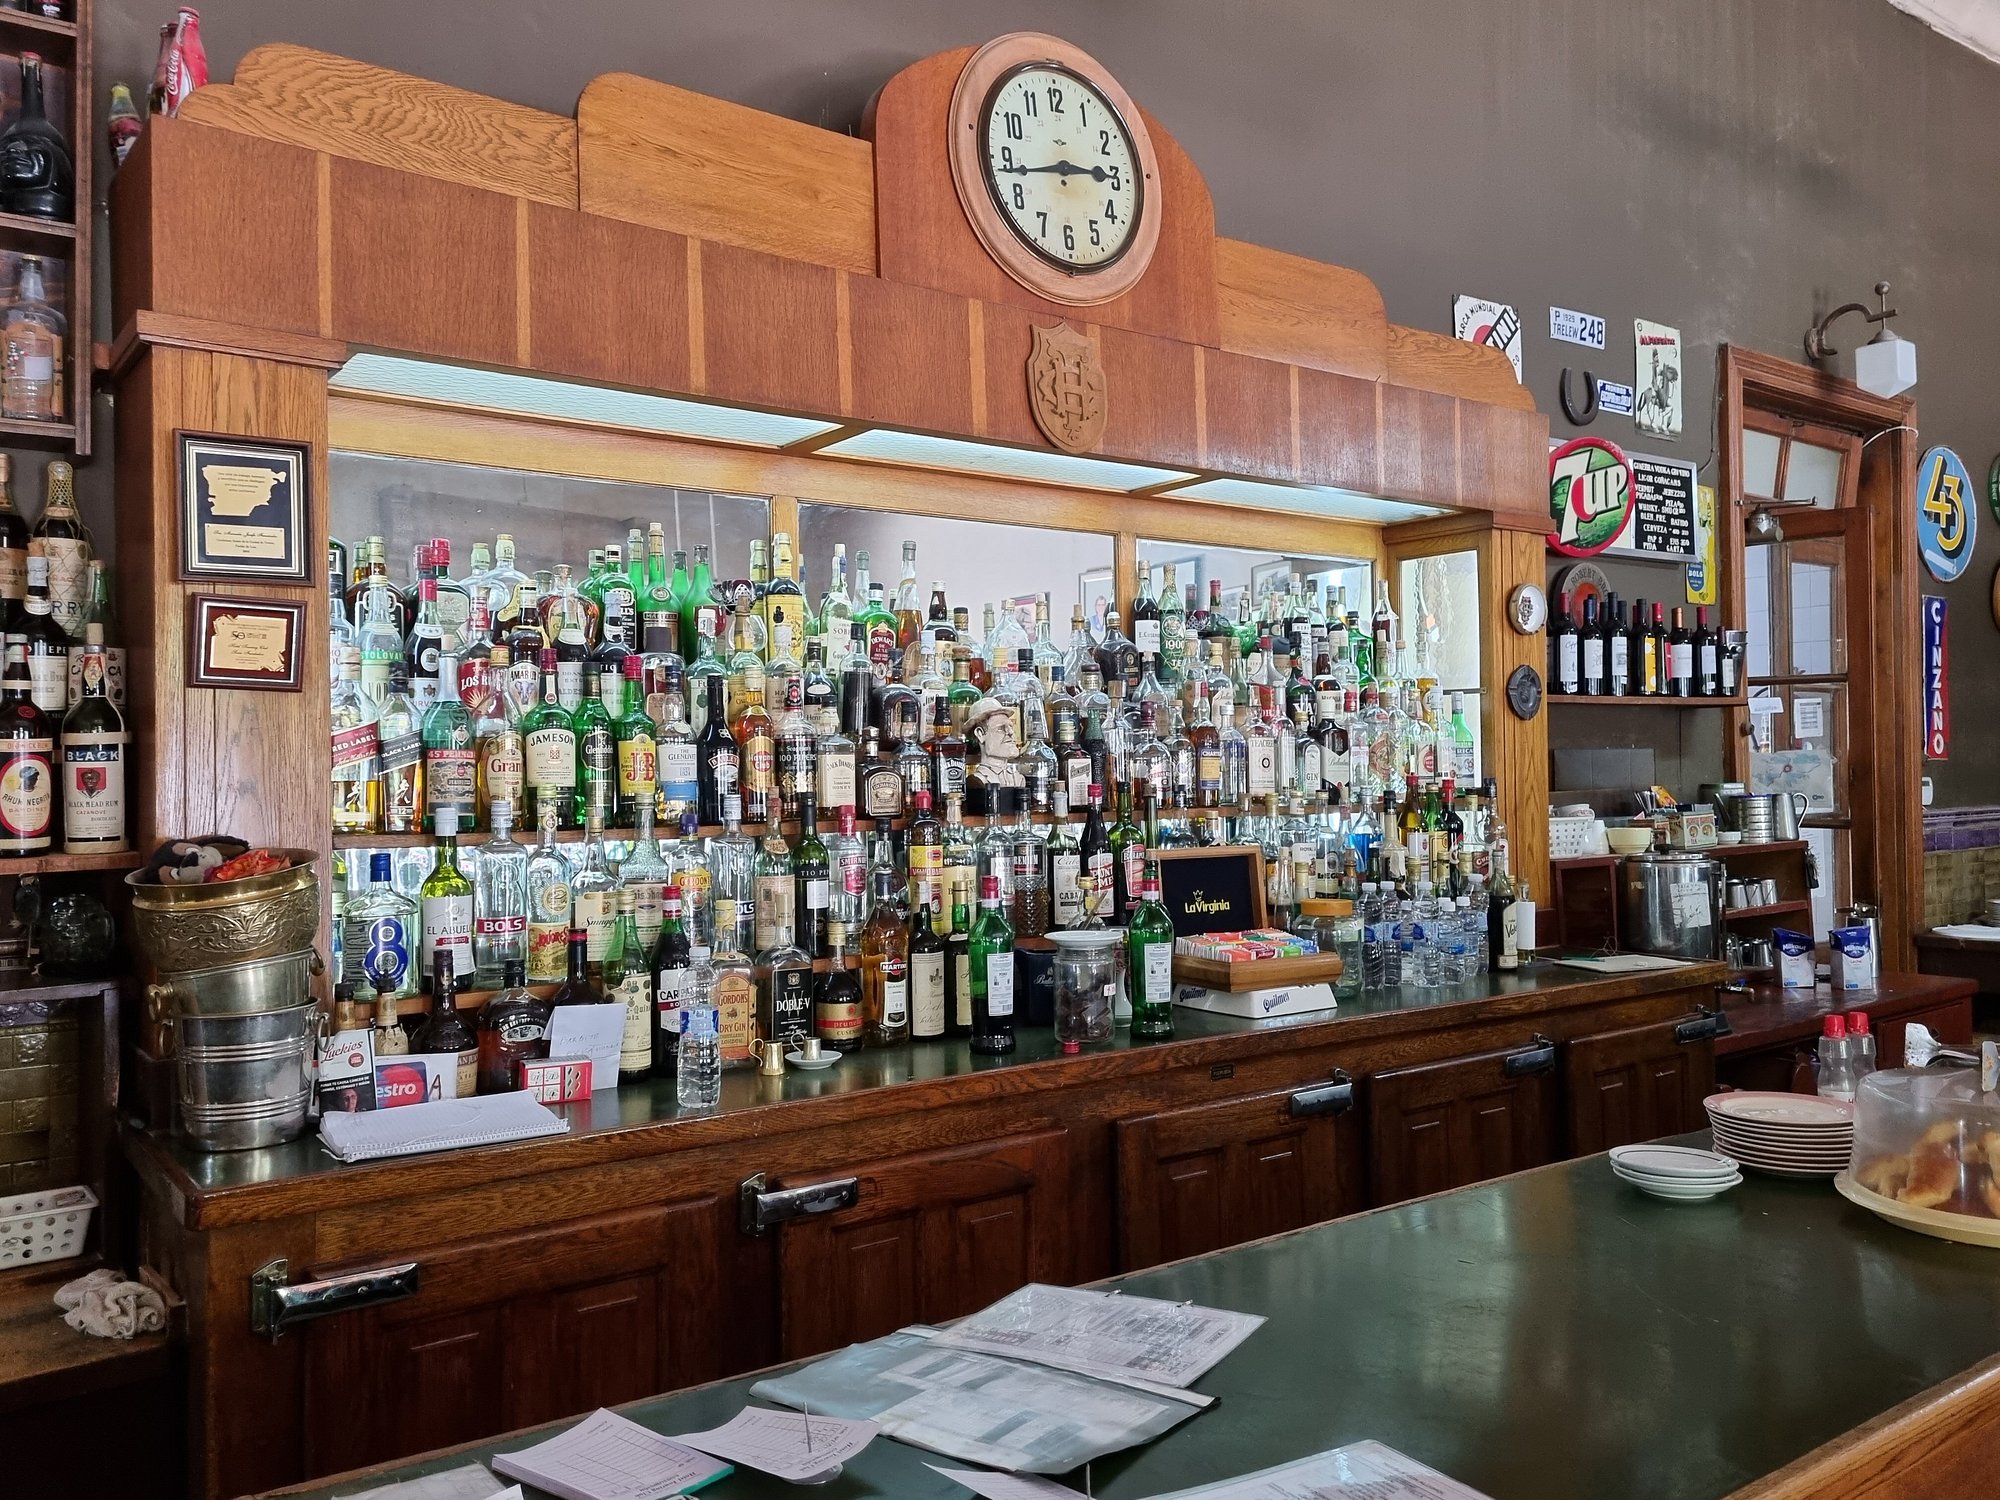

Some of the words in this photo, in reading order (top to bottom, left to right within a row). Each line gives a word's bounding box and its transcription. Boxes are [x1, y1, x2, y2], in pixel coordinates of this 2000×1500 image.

[1023, 91, 1037, 117] 11
[1046, 87, 1064, 114] 12
[1079, 102, 1087, 127] 1
[1004, 112, 1023, 140] 10
[1100, 130, 1110, 156] 2
[1002, 146, 1013, 170] 9
[1110, 166, 1120, 191] 3
[1012, 184, 1024, 210] 8
[1105, 199, 1118, 224] 4
[1036, 212, 1047, 238] 7
[1089, 220, 1100, 246] 5
[1063, 225, 1074, 250] 6
[1469, 303, 1497, 316] MUNDIAL
[1553, 322, 1579, 338] TRELEW
[1555, 310, 1560, 322] P
[1580, 317, 1604, 345] 248
[1643, 524, 1667, 534] CERVEZA
[871, 637, 894, 646] DEWAR'S
[461, 676, 479, 691] LOS
[1931, 601, 1944, 755] CINZANO
[332, 742, 349, 752] RED
[350, 734, 376, 748] LABEL
[530, 733, 574, 746] JAMESON
[67, 751, 118, 761] BLACK
[382, 748, 402, 759] BLACK
[403, 741, 422, 751] LABEL
[2, 794, 22, 805] RHUM
[1196, 899, 1230, 914] Virginia
[427, 926, 437, 935] EL
[483, 918, 522, 932] BOLS
[719, 993, 749, 1006] GORDON'S
[776, 997, 810, 1012] DOBLE-V
[1263, 992, 1290, 1012] Quilmes
[720, 1024, 732, 1033] DRY
[734, 1023, 746, 1032] GIN
[321, 1040, 363, 1064] Luckies
[428, 1074, 442, 1100] A
